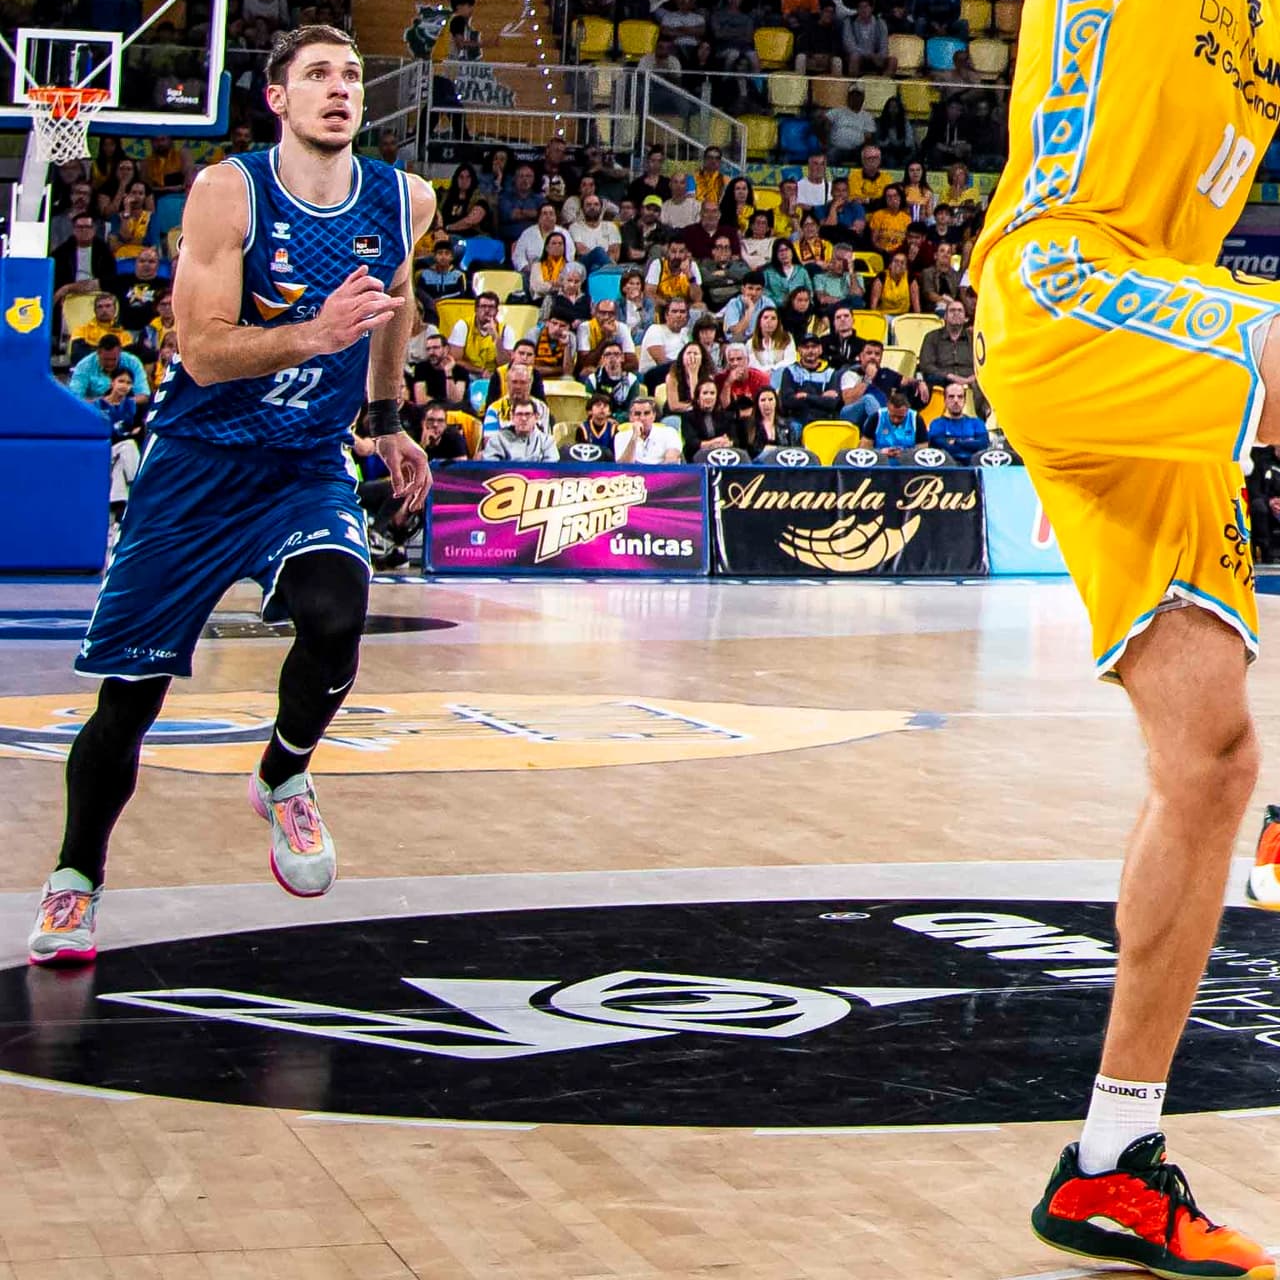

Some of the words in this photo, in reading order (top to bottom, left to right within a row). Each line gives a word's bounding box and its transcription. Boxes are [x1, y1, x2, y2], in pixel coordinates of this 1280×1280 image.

[1196, 122, 1256, 208] 18
[261, 368, 323, 410] 22
[721, 474, 885, 510] Amanda
[896, 475, 978, 510] Bus
[444, 545, 517, 558] tirma.com
[609, 533, 694, 557] únicas
